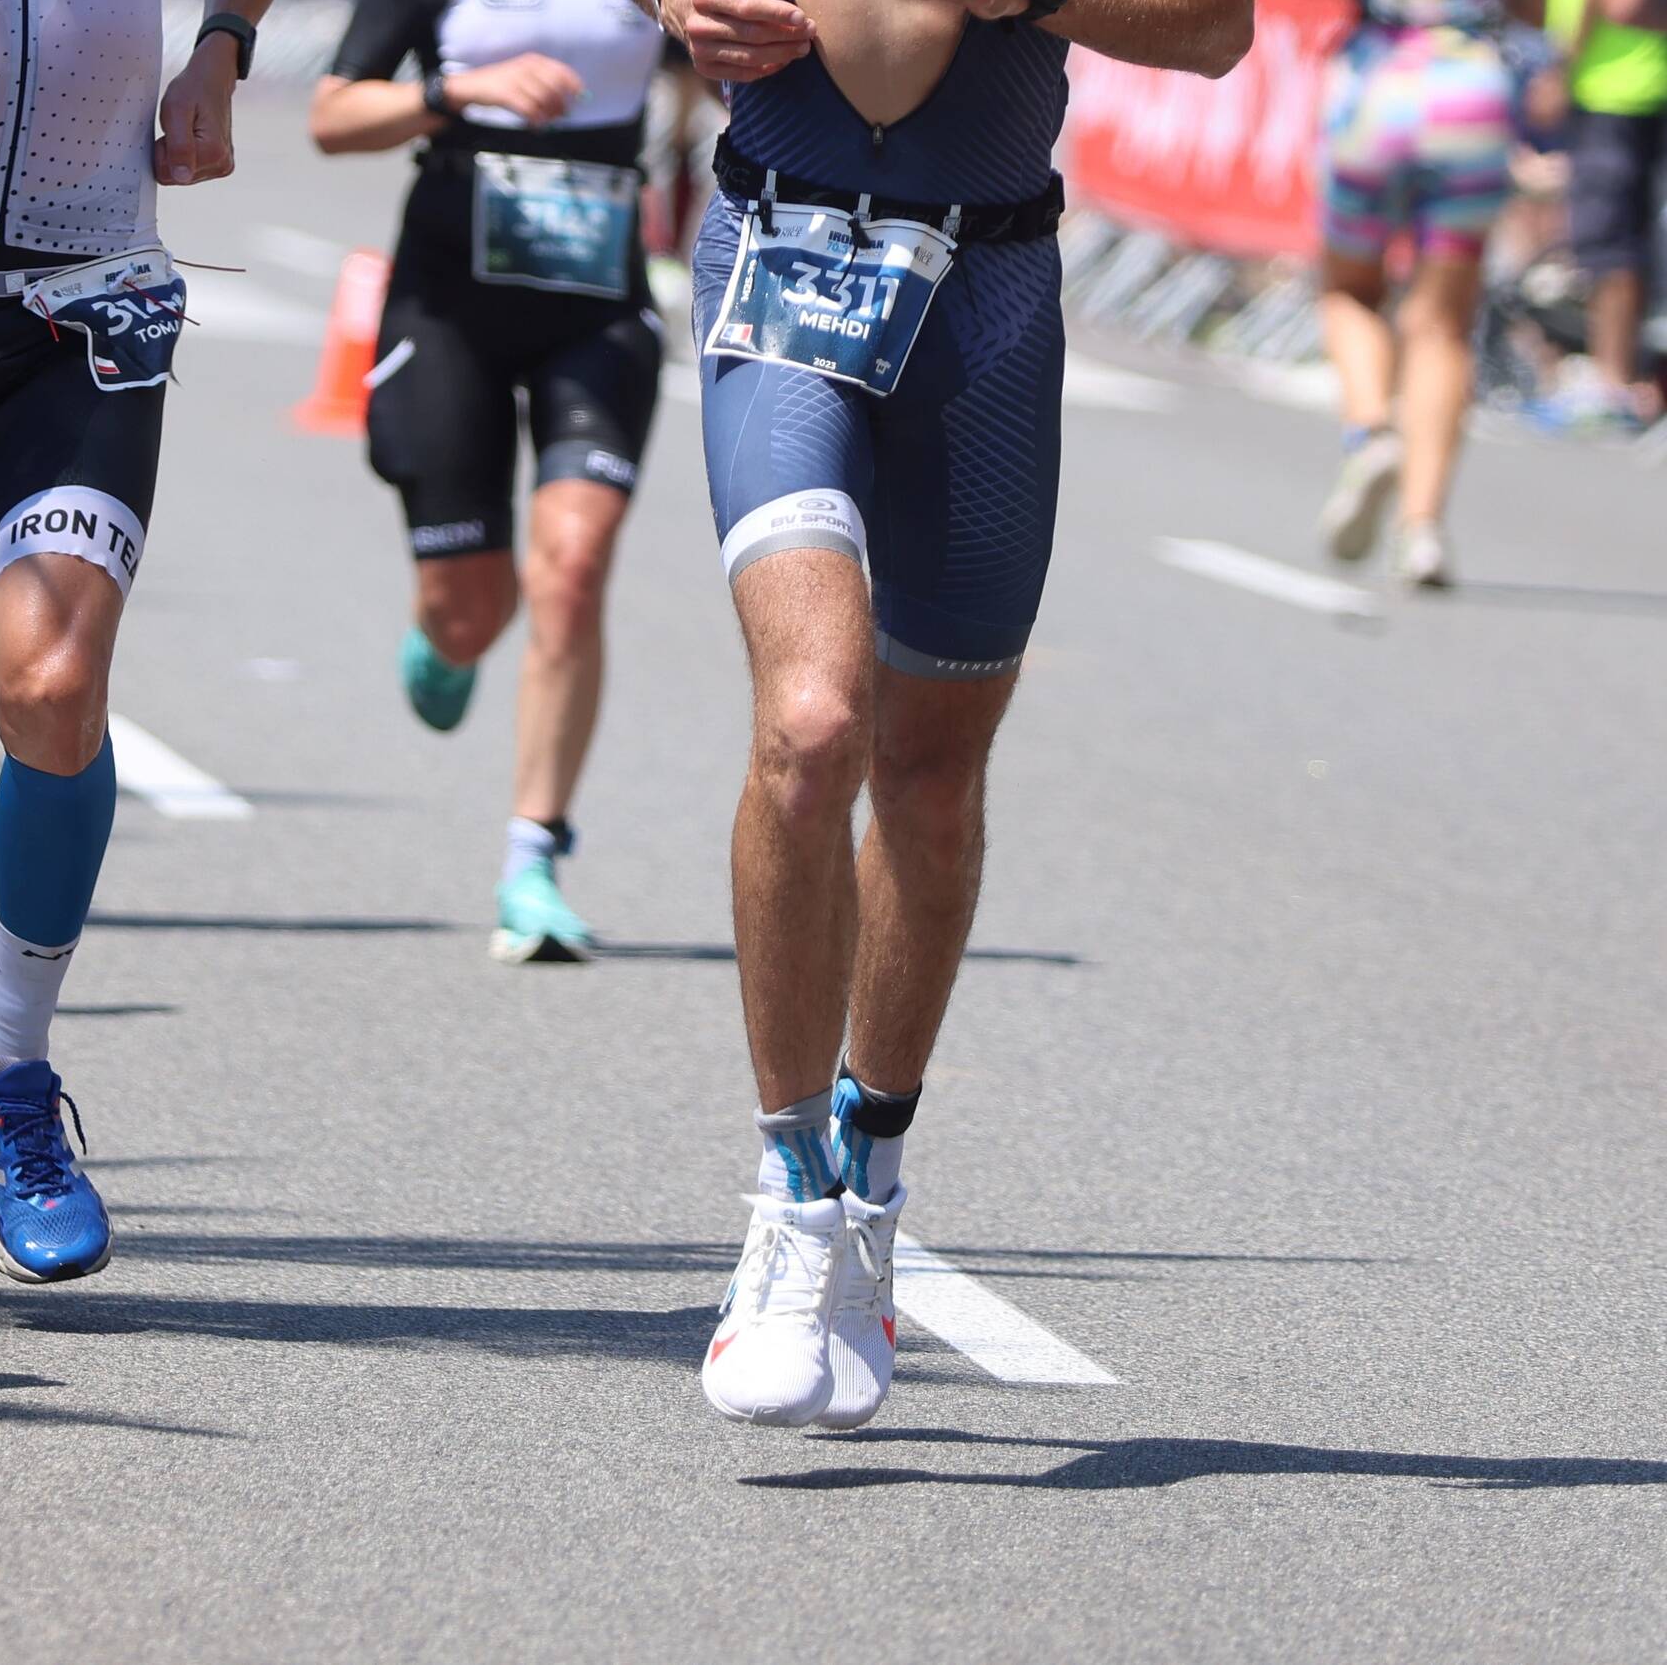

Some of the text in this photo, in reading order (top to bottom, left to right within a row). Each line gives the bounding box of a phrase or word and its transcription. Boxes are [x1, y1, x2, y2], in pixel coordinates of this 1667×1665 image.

[782, 261, 900, 320] 3311
[799, 310, 871, 339] MEHDI
[813, 357, 837, 370] 2023
[10, 509, 98, 545] IRON
